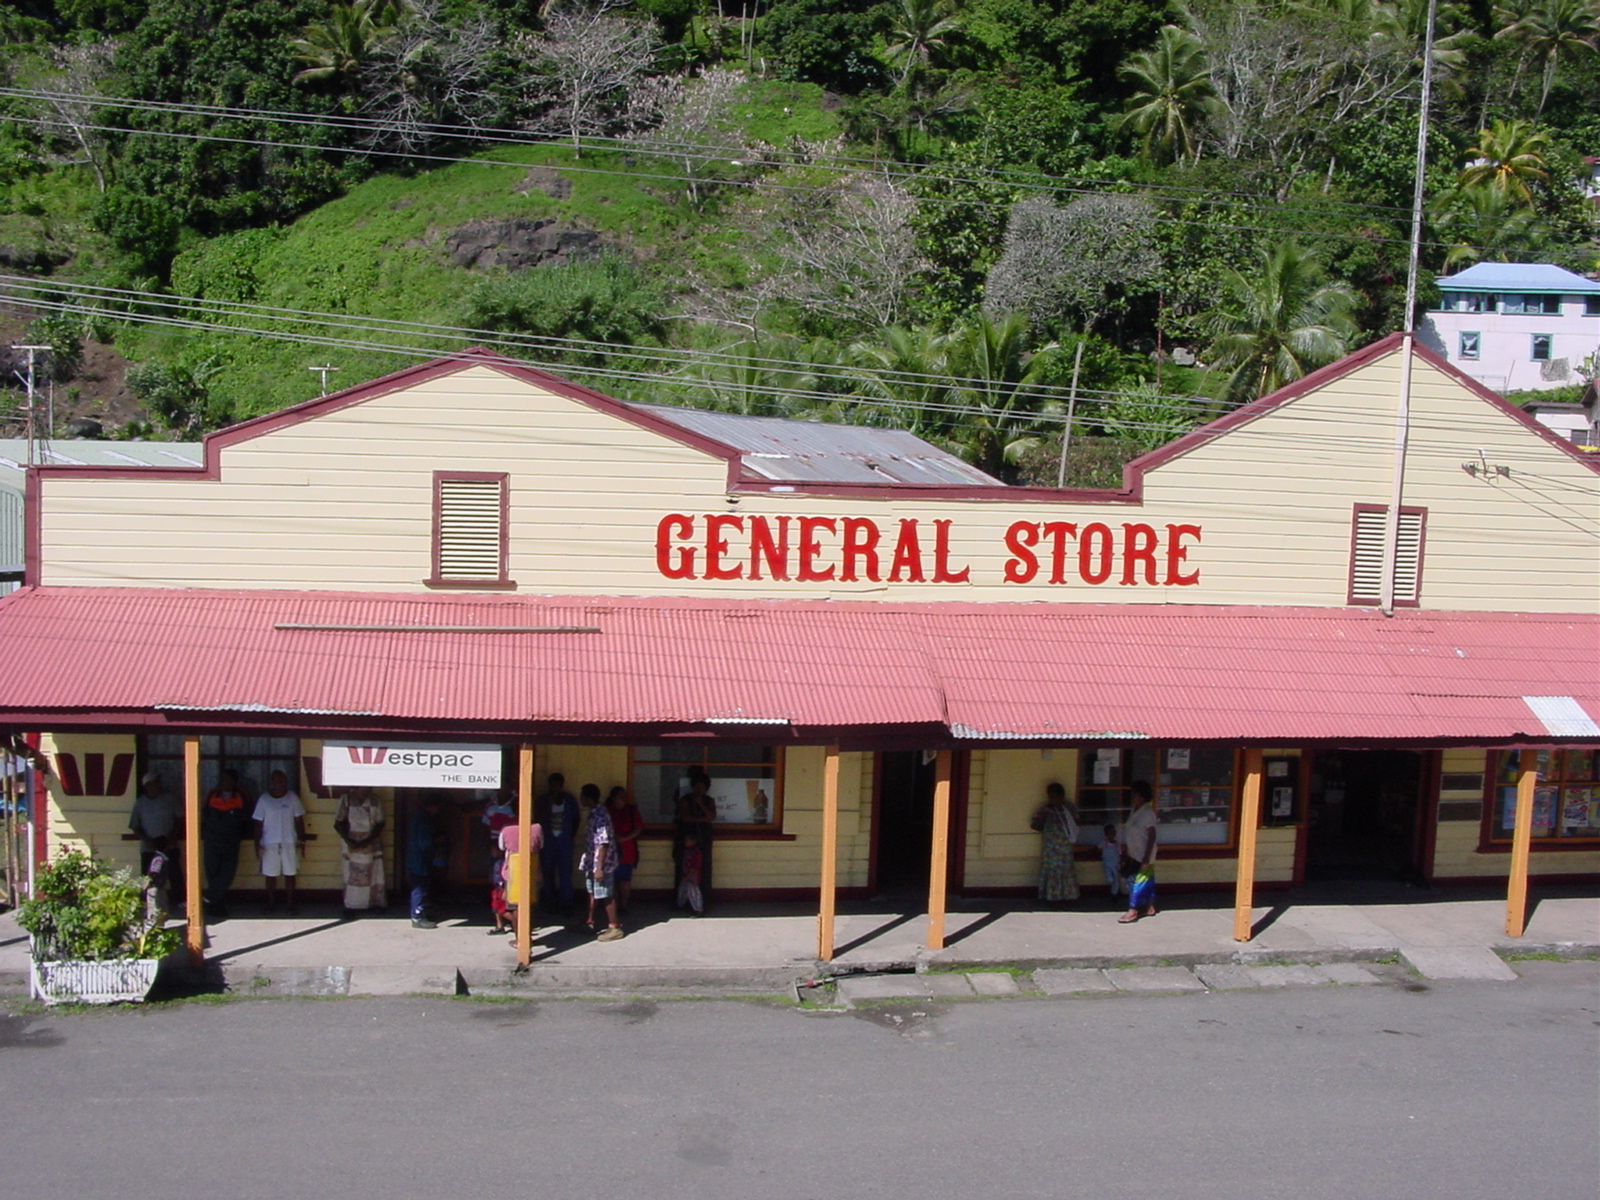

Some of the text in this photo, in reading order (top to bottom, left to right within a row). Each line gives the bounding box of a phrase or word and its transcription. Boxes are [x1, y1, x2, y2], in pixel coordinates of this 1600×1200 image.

[655, 513, 1202, 586] GENERAL STORE
[347, 746, 474, 769] Westpac
[441, 774, 498, 784] THE BANK
